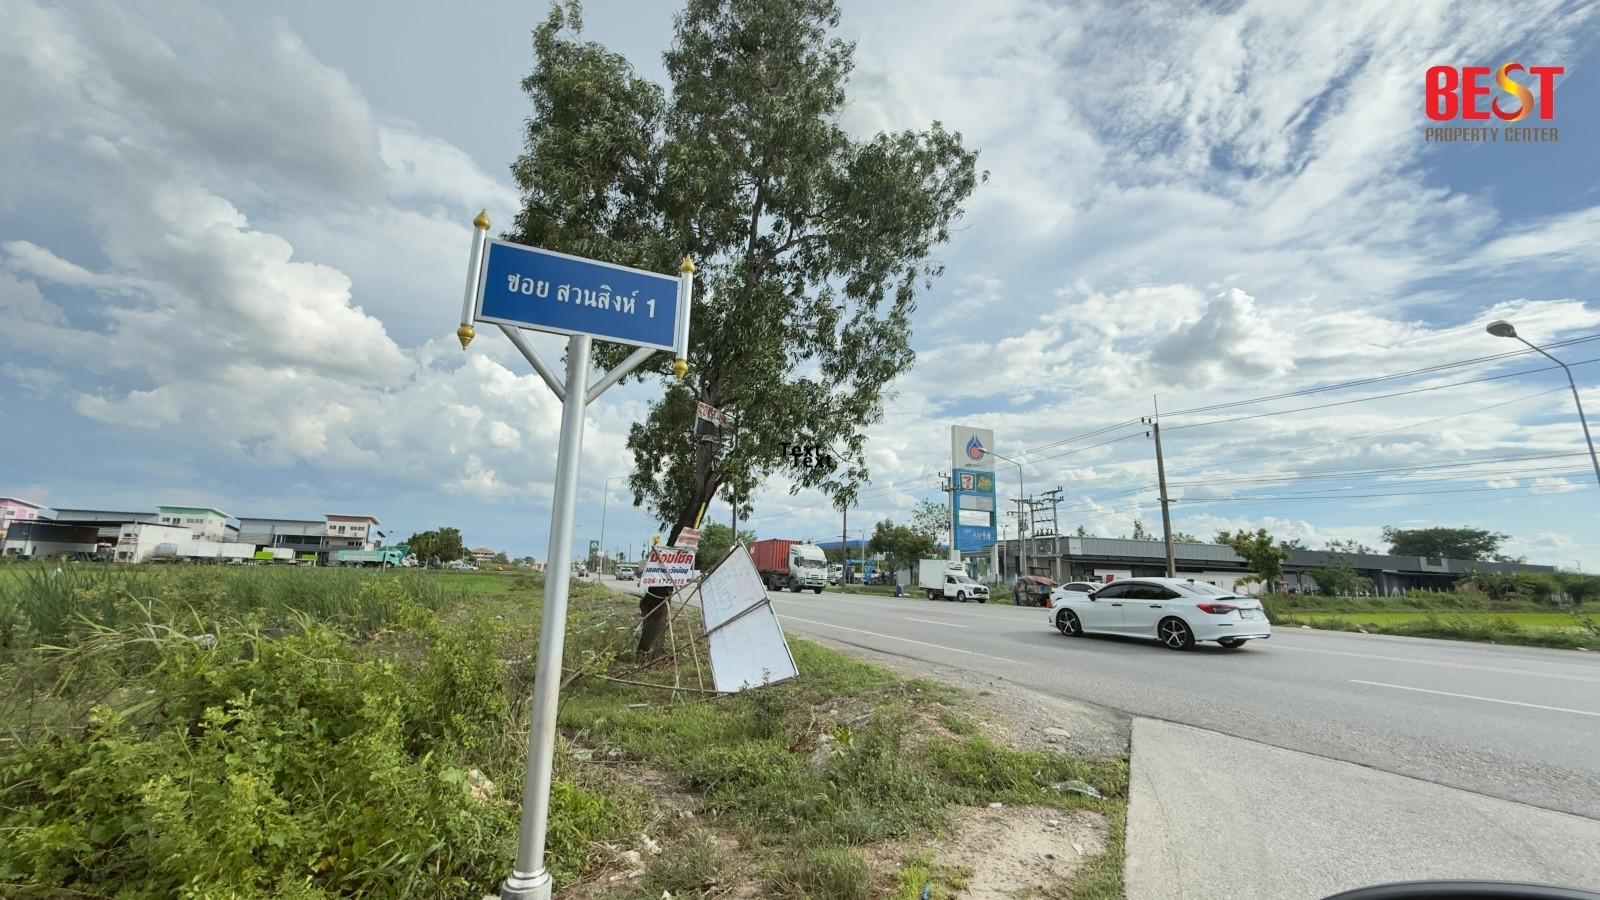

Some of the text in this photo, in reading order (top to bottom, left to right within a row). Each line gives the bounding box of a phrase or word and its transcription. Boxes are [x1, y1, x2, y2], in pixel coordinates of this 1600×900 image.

[507, 273, 656, 319] ซอย สวนสิงห์ 1
